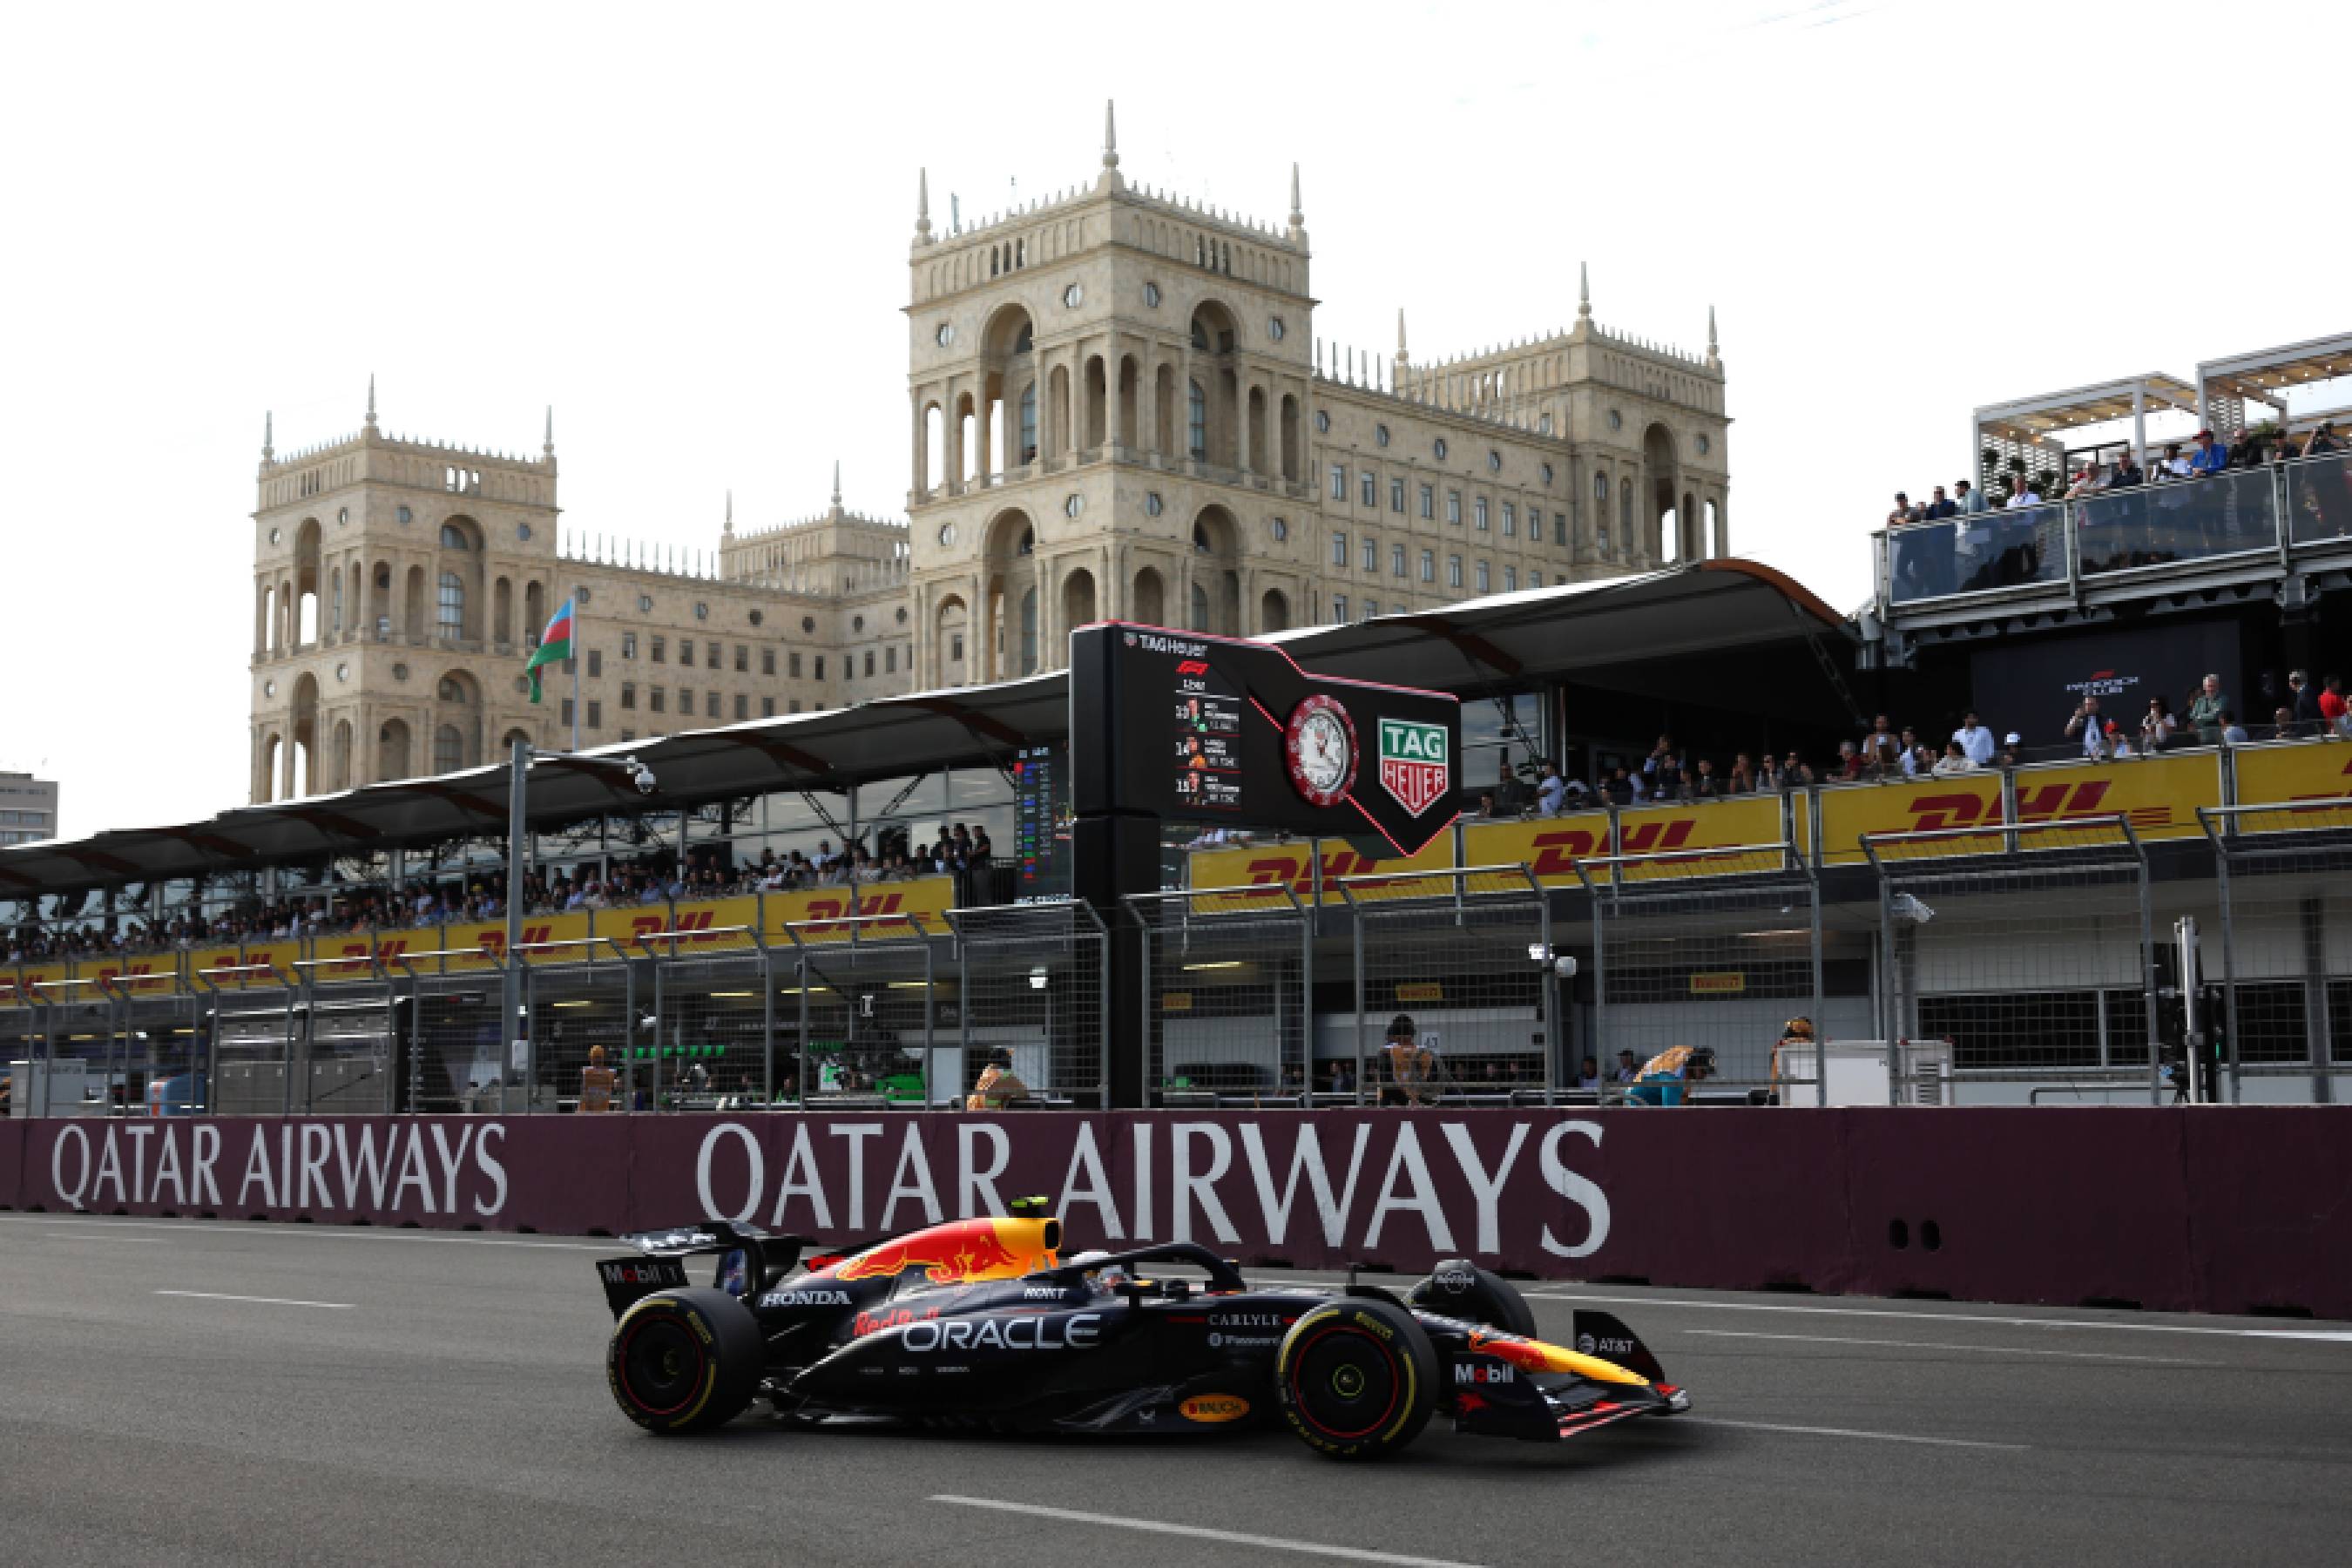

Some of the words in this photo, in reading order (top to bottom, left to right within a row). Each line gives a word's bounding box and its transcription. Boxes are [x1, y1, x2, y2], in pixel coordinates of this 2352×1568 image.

[1385, 727, 1441, 759] TAG
[1384, 760, 1443, 808] HEUER
[1906, 780, 2126, 843] DHL
[1531, 820, 1703, 875] DHL
[1246, 851, 1389, 897] DHL
[632, 911, 717, 947] DHL
[805, 894, 909, 934] DHL
[52, 1123, 223, 1208] QATAR
[237, 1122, 509, 1216] AIRWAYS
[696, 1120, 1010, 1231] QATAR
[1055, 1120, 1611, 1258] AIRWAYS
[604, 1264, 661, 1284] Mobil
[763, 1290, 852, 1307] HONDA
[853, 1309, 897, 1336] Red
[902, 1314, 1101, 1352] ORACLE
[1598, 1340, 1634, 1353] AT&T
[1455, 1363, 1514, 1383] Mobil
